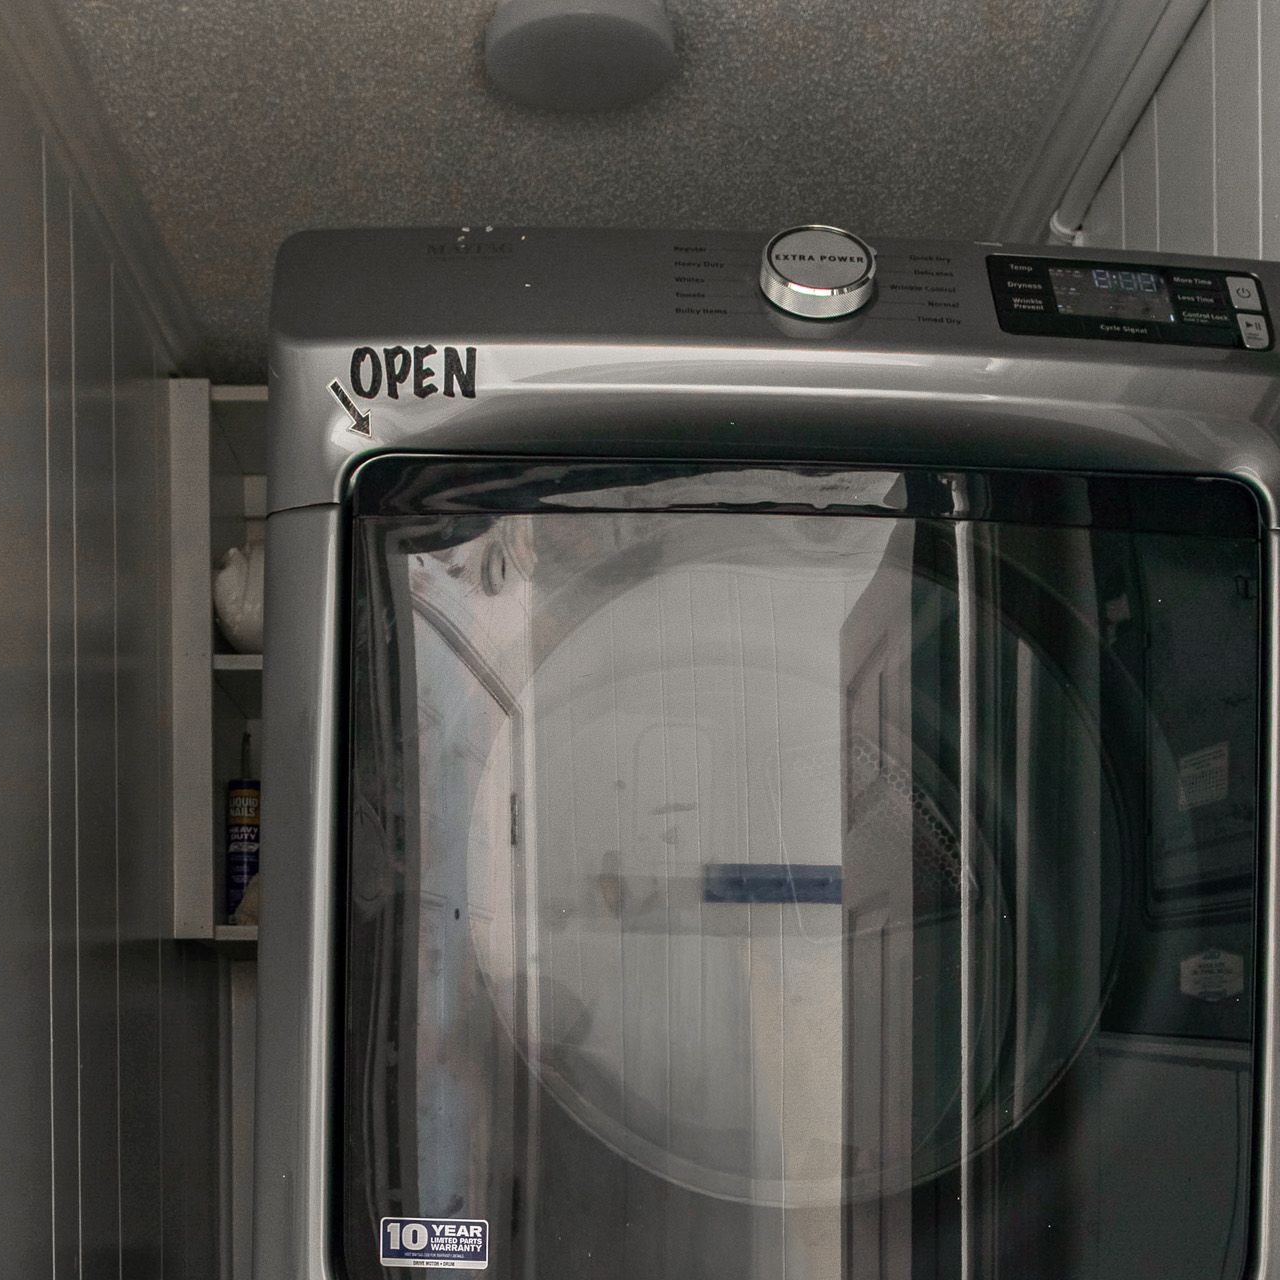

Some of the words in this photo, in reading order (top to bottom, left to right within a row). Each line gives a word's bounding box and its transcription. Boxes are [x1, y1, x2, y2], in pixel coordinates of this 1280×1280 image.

[820, 255, 864, 263] POWER
[1009, 264, 1033, 273] Temp
[1007, 281, 1043, 290] Dryness
[1193, 278, 1212, 286] Time
[1012, 297, 1043, 305] Wrinkle
[1197, 296, 1214, 304] Time
[675, 307, 700, 315] Bulky
[1014, 303, 1045, 312] Prevent
[1182, 311, 1210, 319] Control
[1100, 323, 1120, 333] Cycle
[1122, 324, 1149, 335] Signal
[350, 344, 477, 399] OPEN
[387, 1222, 428, 1250] 10
[431, 1224, 482, 1238] YEAR
[430, 1244, 482, 1252] WARRANTY
